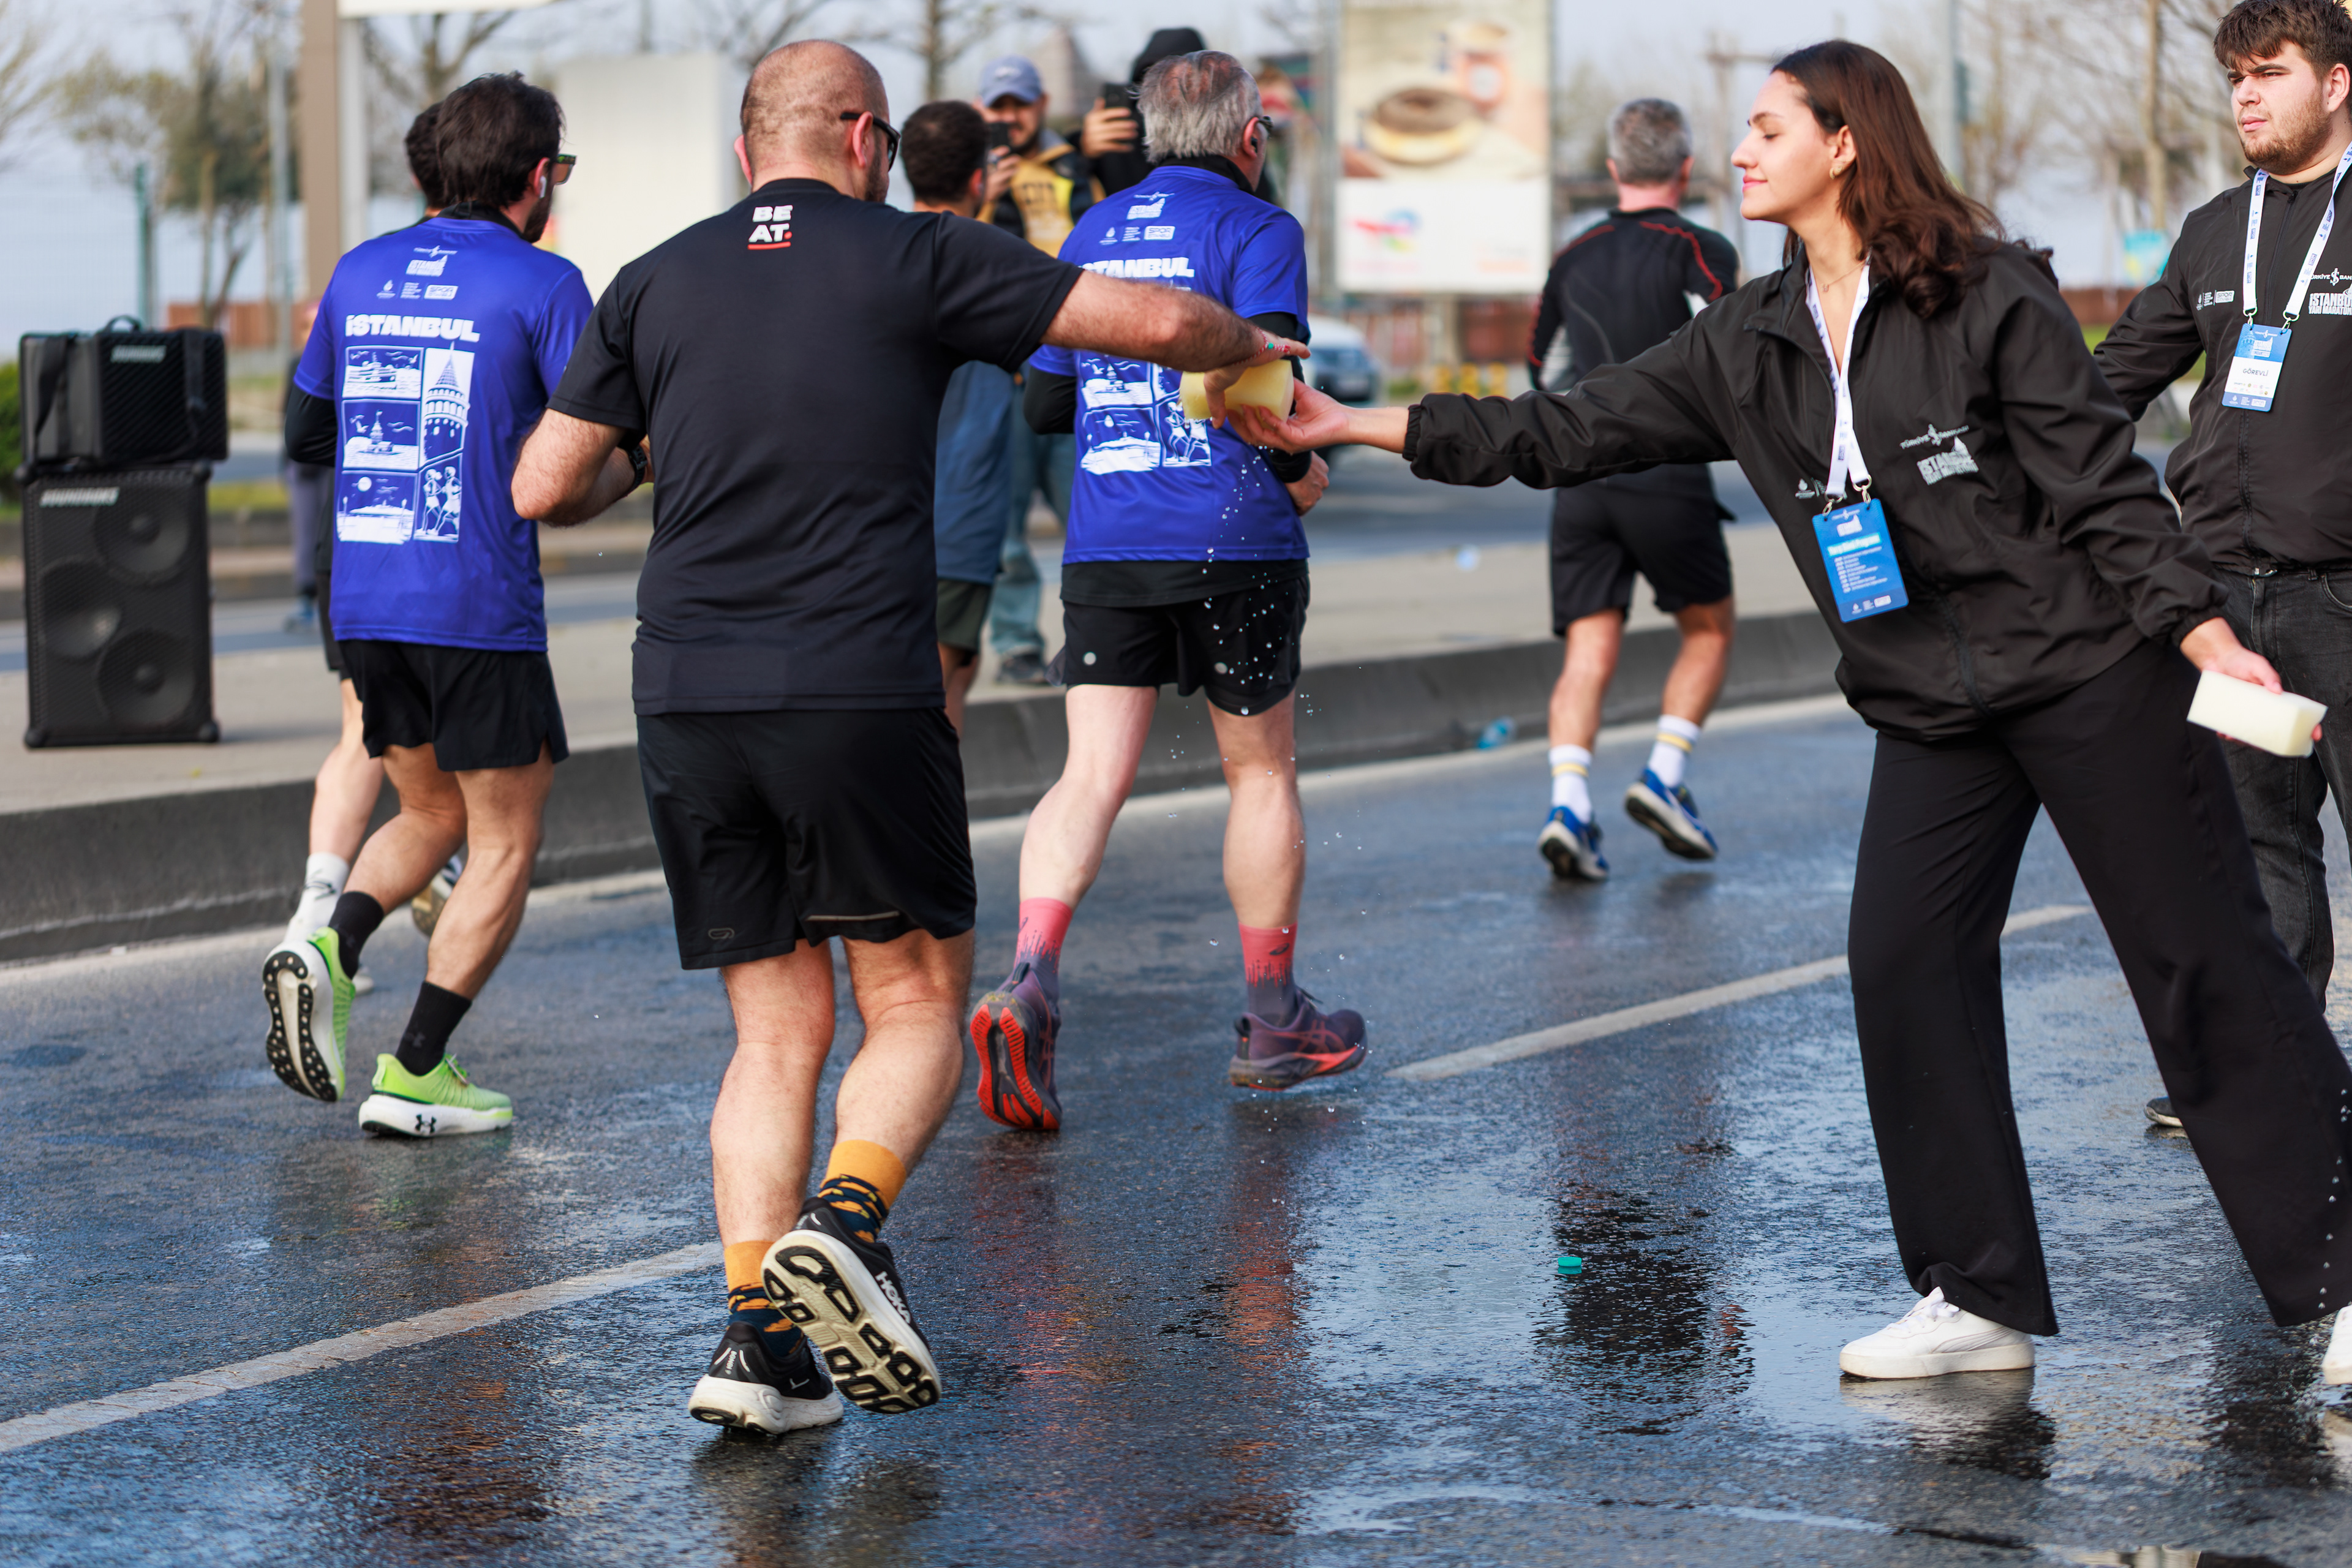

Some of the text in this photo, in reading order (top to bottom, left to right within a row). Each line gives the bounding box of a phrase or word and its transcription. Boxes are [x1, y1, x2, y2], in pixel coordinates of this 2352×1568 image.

[753, 205, 793, 222] BE
[345, 314, 481, 343] İSTANBUL
[2242, 368, 2269, 377] GÖREVLİ
[875, 1270, 911, 1324] HOKA
